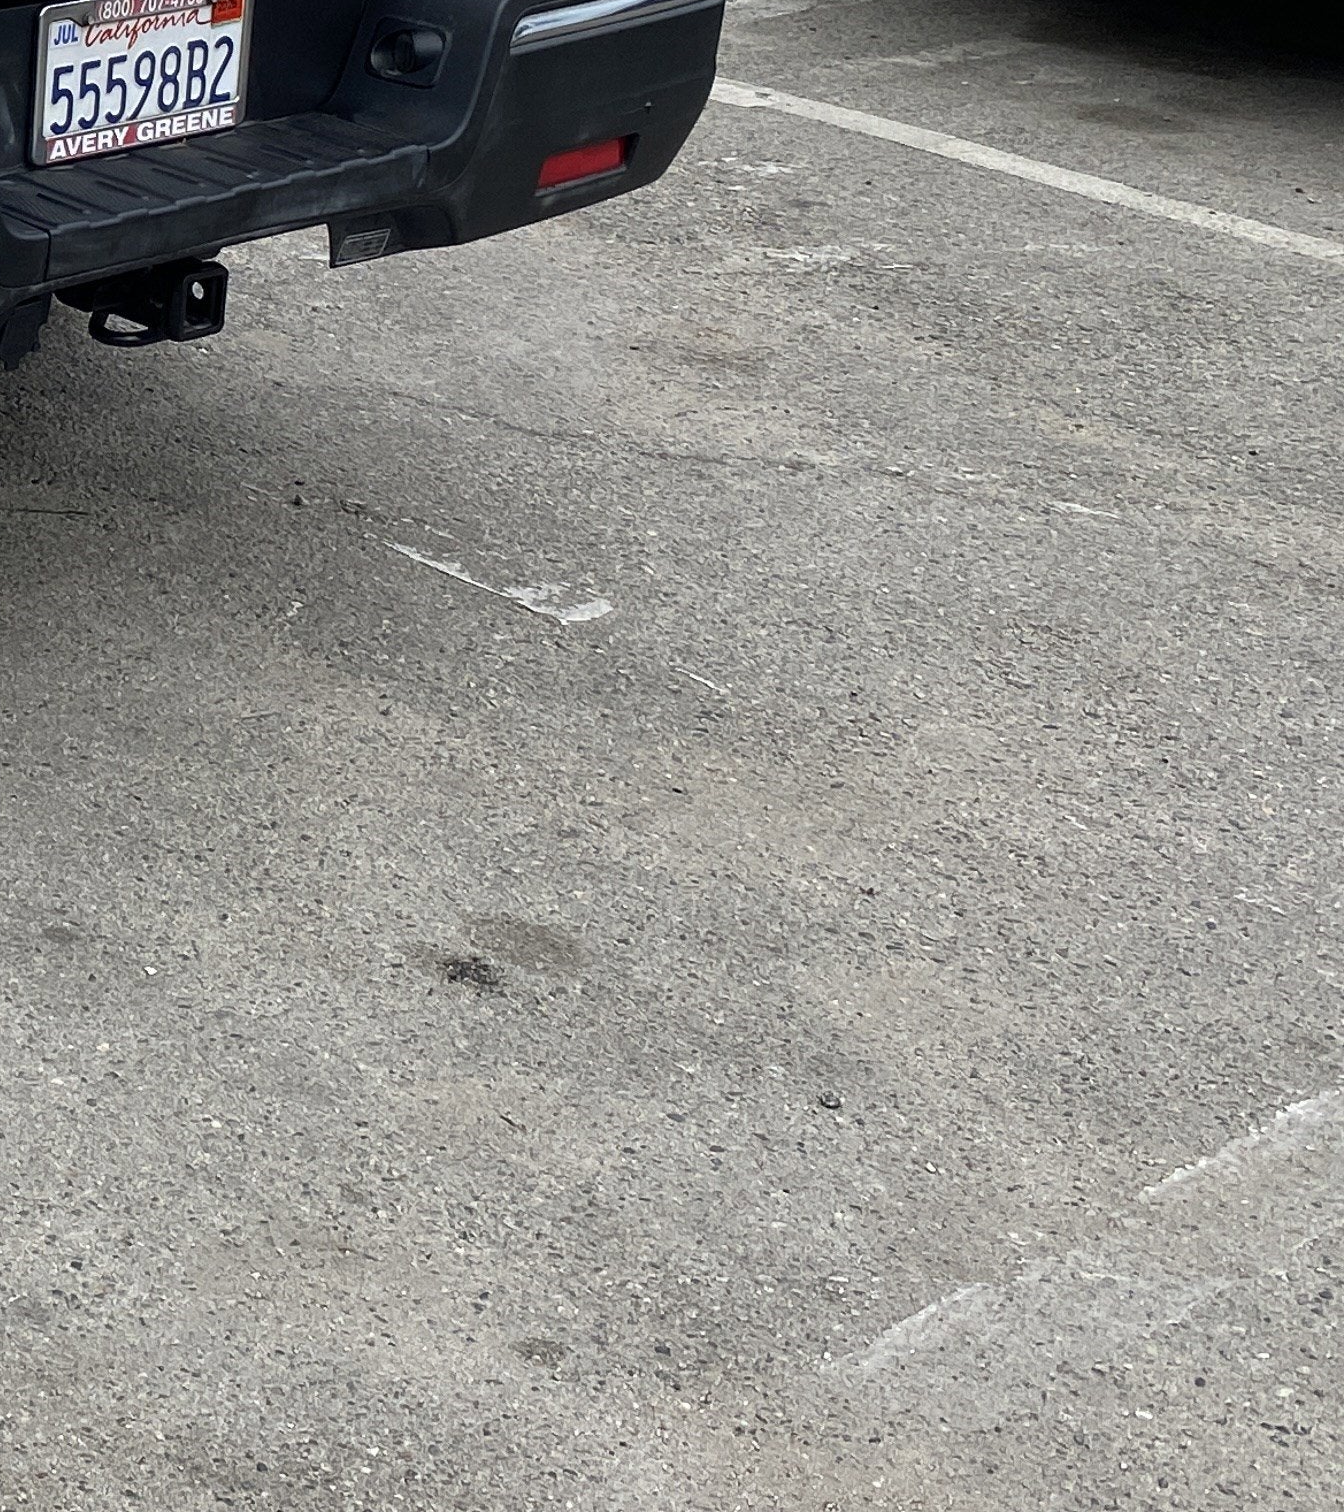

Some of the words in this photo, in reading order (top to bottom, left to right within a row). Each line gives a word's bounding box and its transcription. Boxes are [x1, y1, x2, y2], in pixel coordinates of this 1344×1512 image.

[53, 24, 79, 46] JUL
[85, 8, 211, 49] California
[50, 35, 234, 136] 55598B2
[49, 125, 129, 160] AVERY
[136, 107, 234, 141] GREENE
